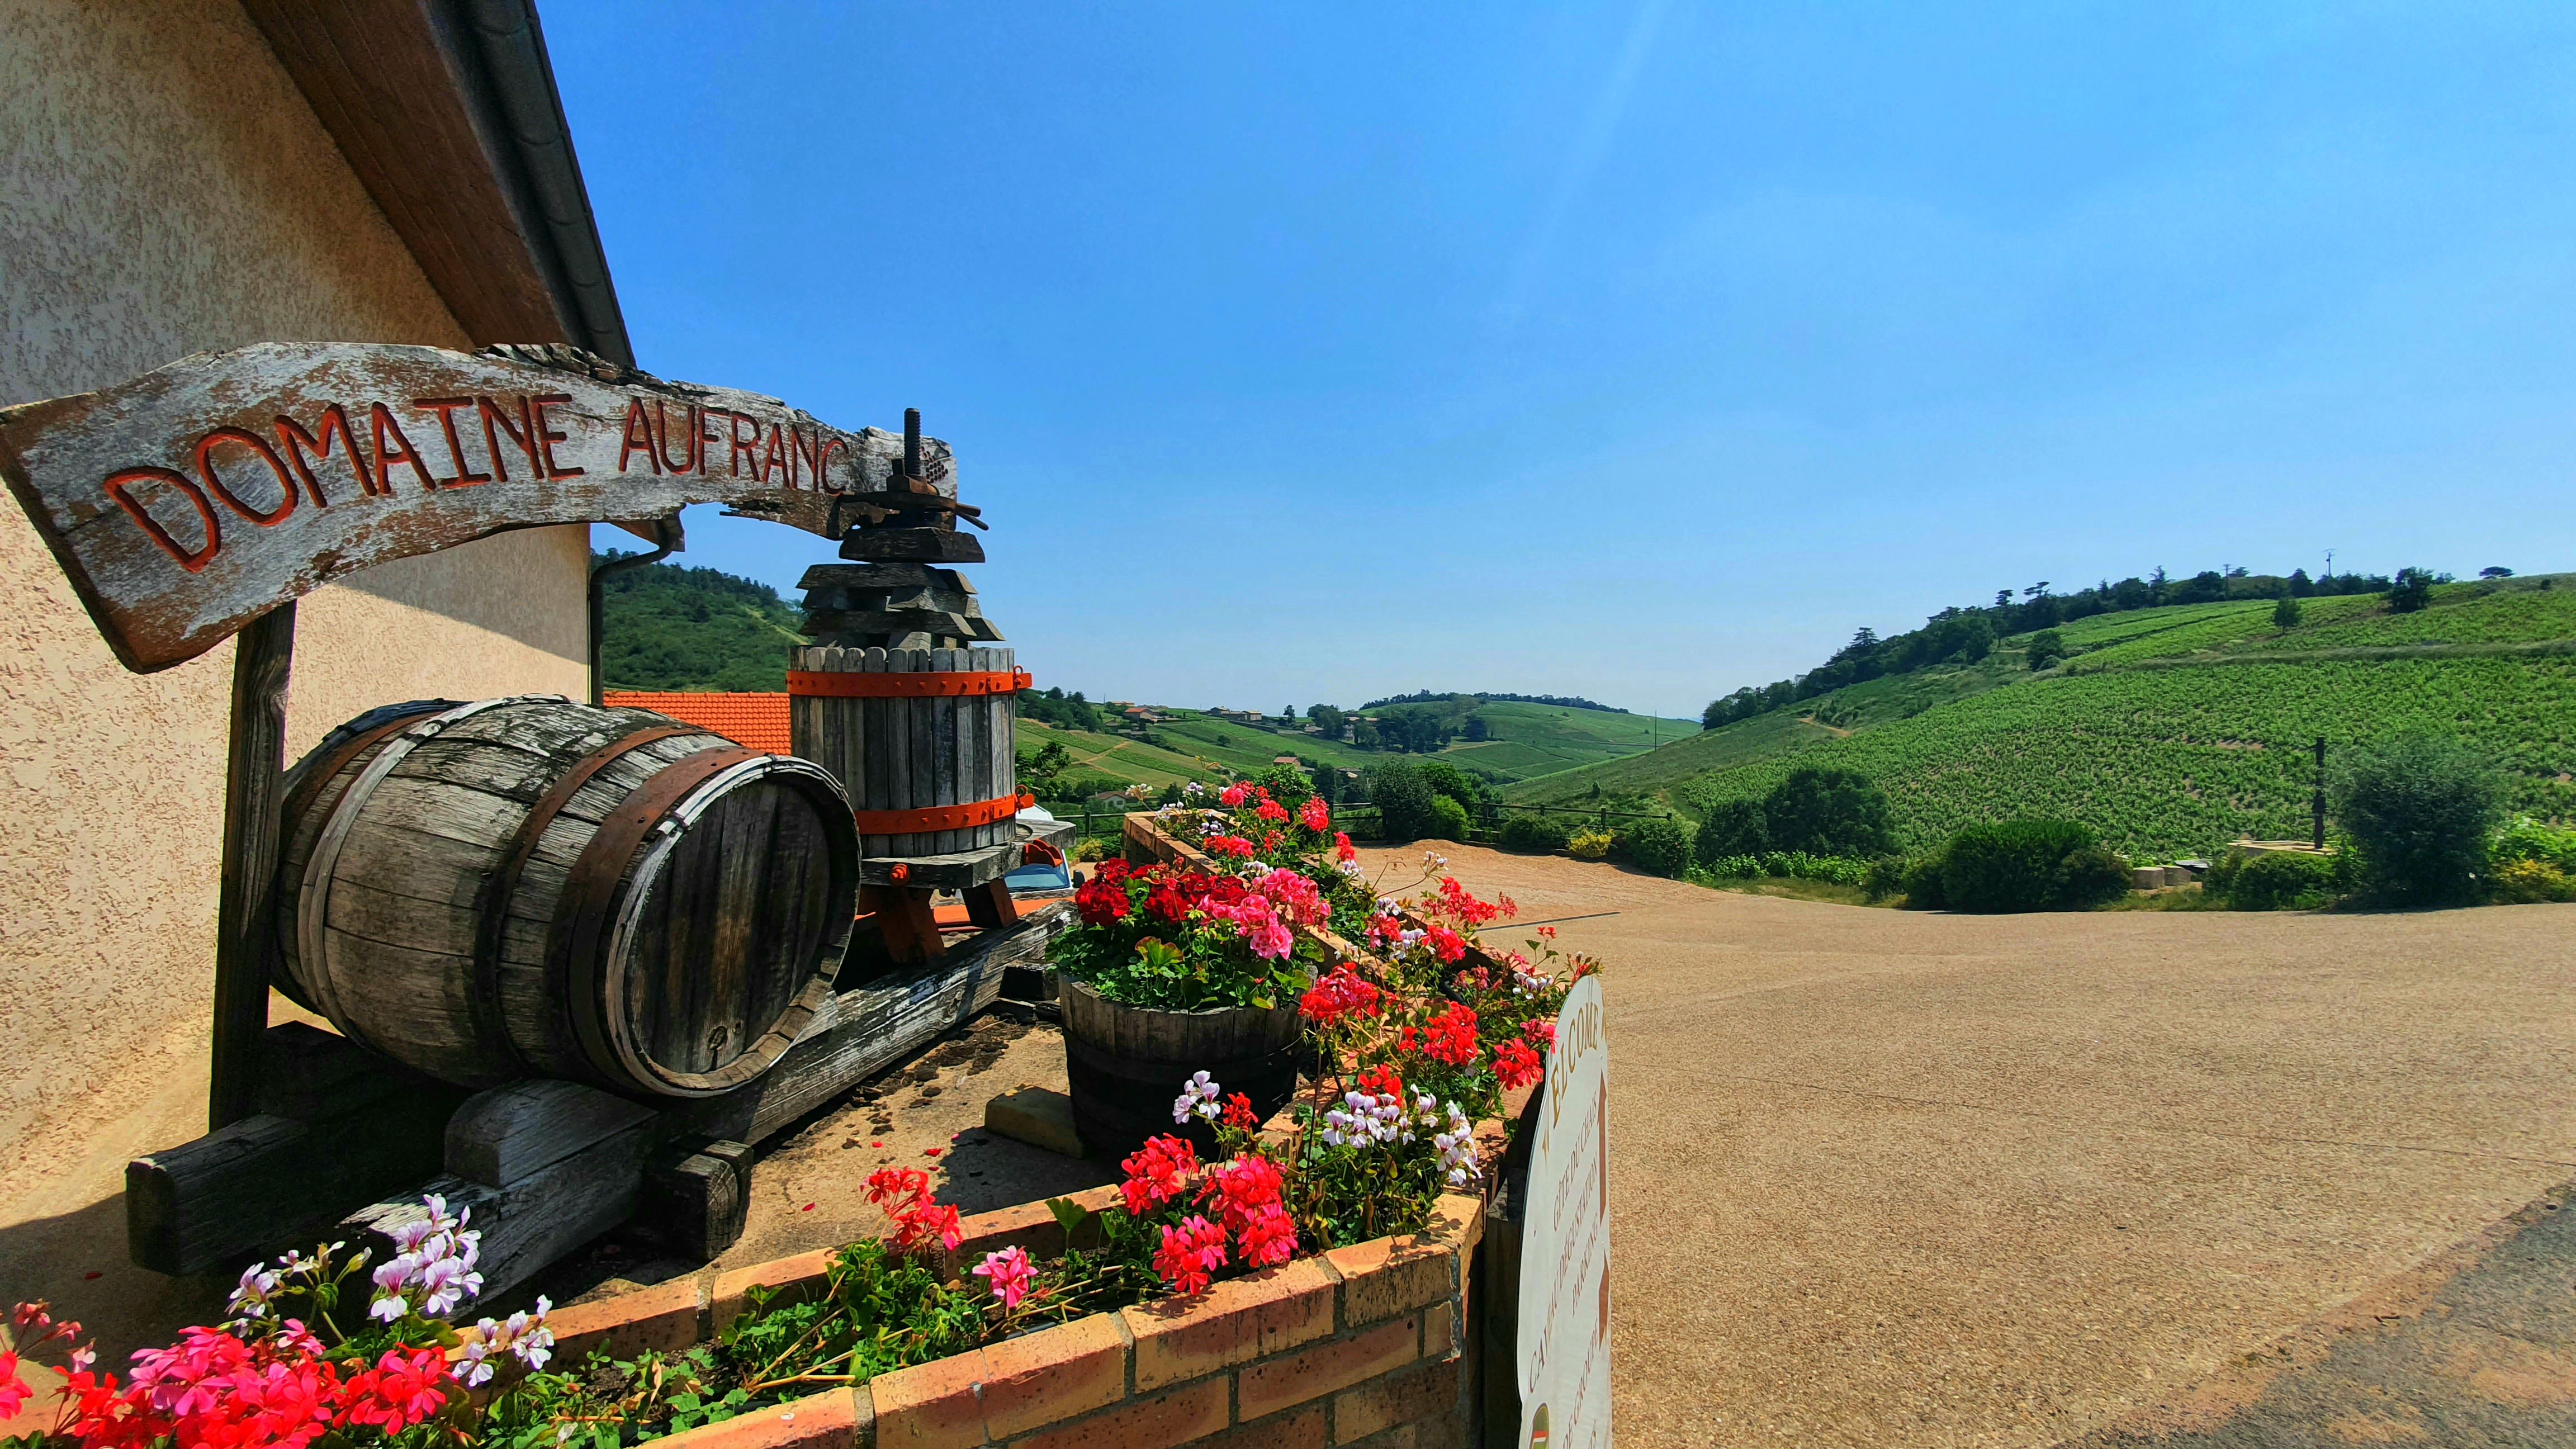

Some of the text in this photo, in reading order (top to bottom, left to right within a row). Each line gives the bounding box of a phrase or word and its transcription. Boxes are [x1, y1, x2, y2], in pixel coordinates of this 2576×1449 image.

[104, 394, 849, 573] DOMAINE AUFRANC
[1554, 1091, 1597, 1231] GÎTE DU CHAIS
[1573, 1212, 1598, 1318] PARKING
[1574, 1317, 1598, 1426] GROUPE
